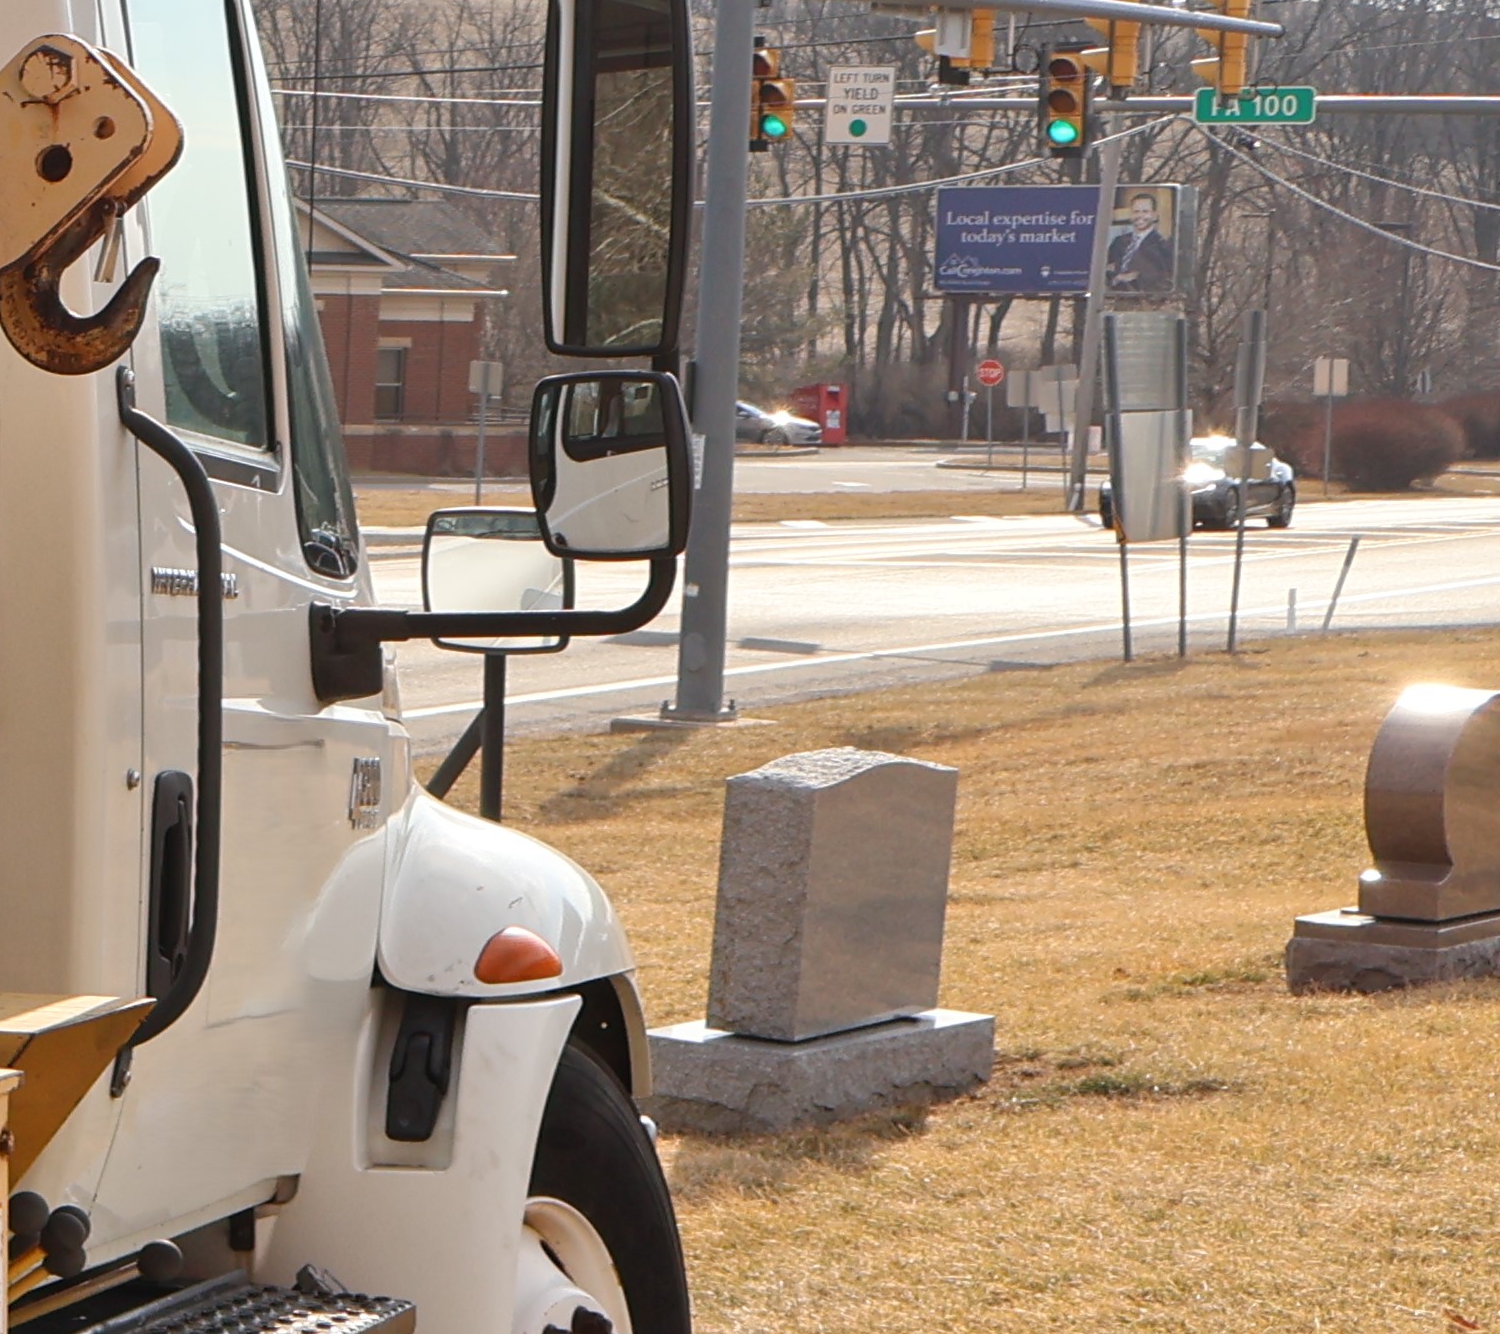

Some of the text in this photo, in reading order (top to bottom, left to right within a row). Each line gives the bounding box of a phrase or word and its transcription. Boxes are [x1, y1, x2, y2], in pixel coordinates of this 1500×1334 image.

[833, 73, 890, 84] LEFT TURN
[844, 88, 879, 100] YIELD
[833, 104, 886, 115] ON GREEN
[1252, 95, 1298, 116] 100
[946, 209, 1095, 229] Local expertise for
[961, 228, 1076, 247] today's market
